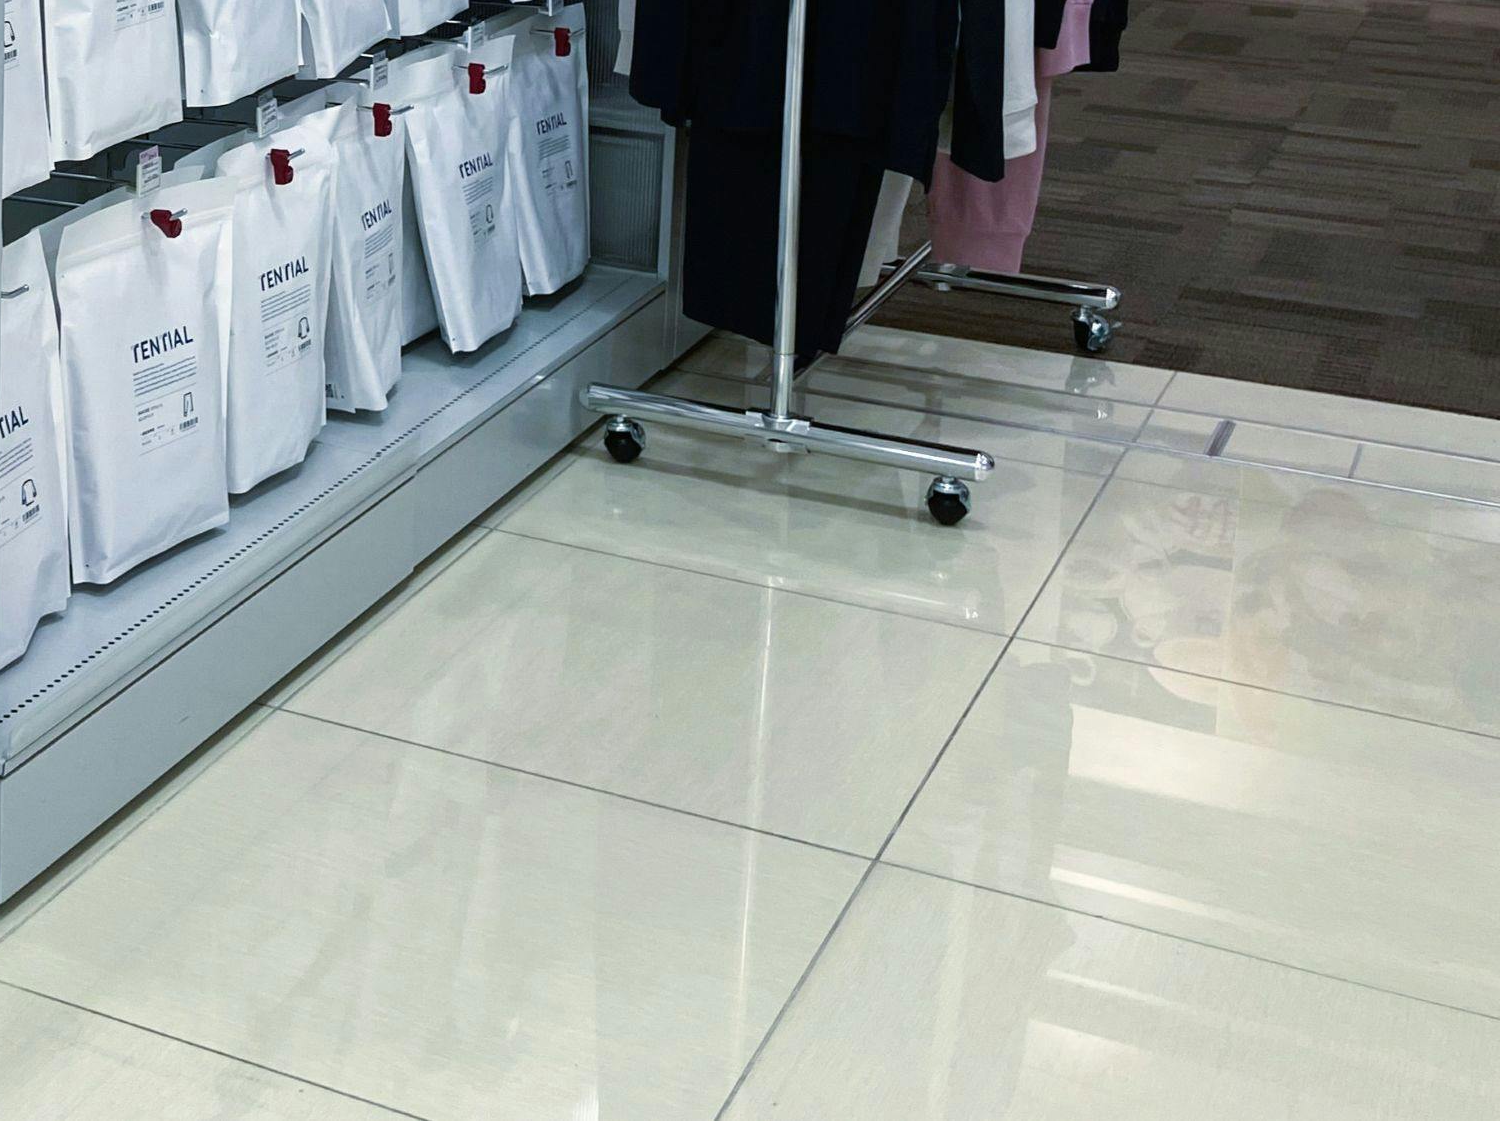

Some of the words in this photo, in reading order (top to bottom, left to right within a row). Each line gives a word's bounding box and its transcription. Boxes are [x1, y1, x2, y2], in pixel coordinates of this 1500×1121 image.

[536, 112, 568, 136] TENTIAL
[459, 152, 493, 179] TENTIAL
[361, 199, 393, 232] TENTIAL
[258, 255, 310, 292] TENTIAL
[131, 325, 194, 364] TENTIAL
